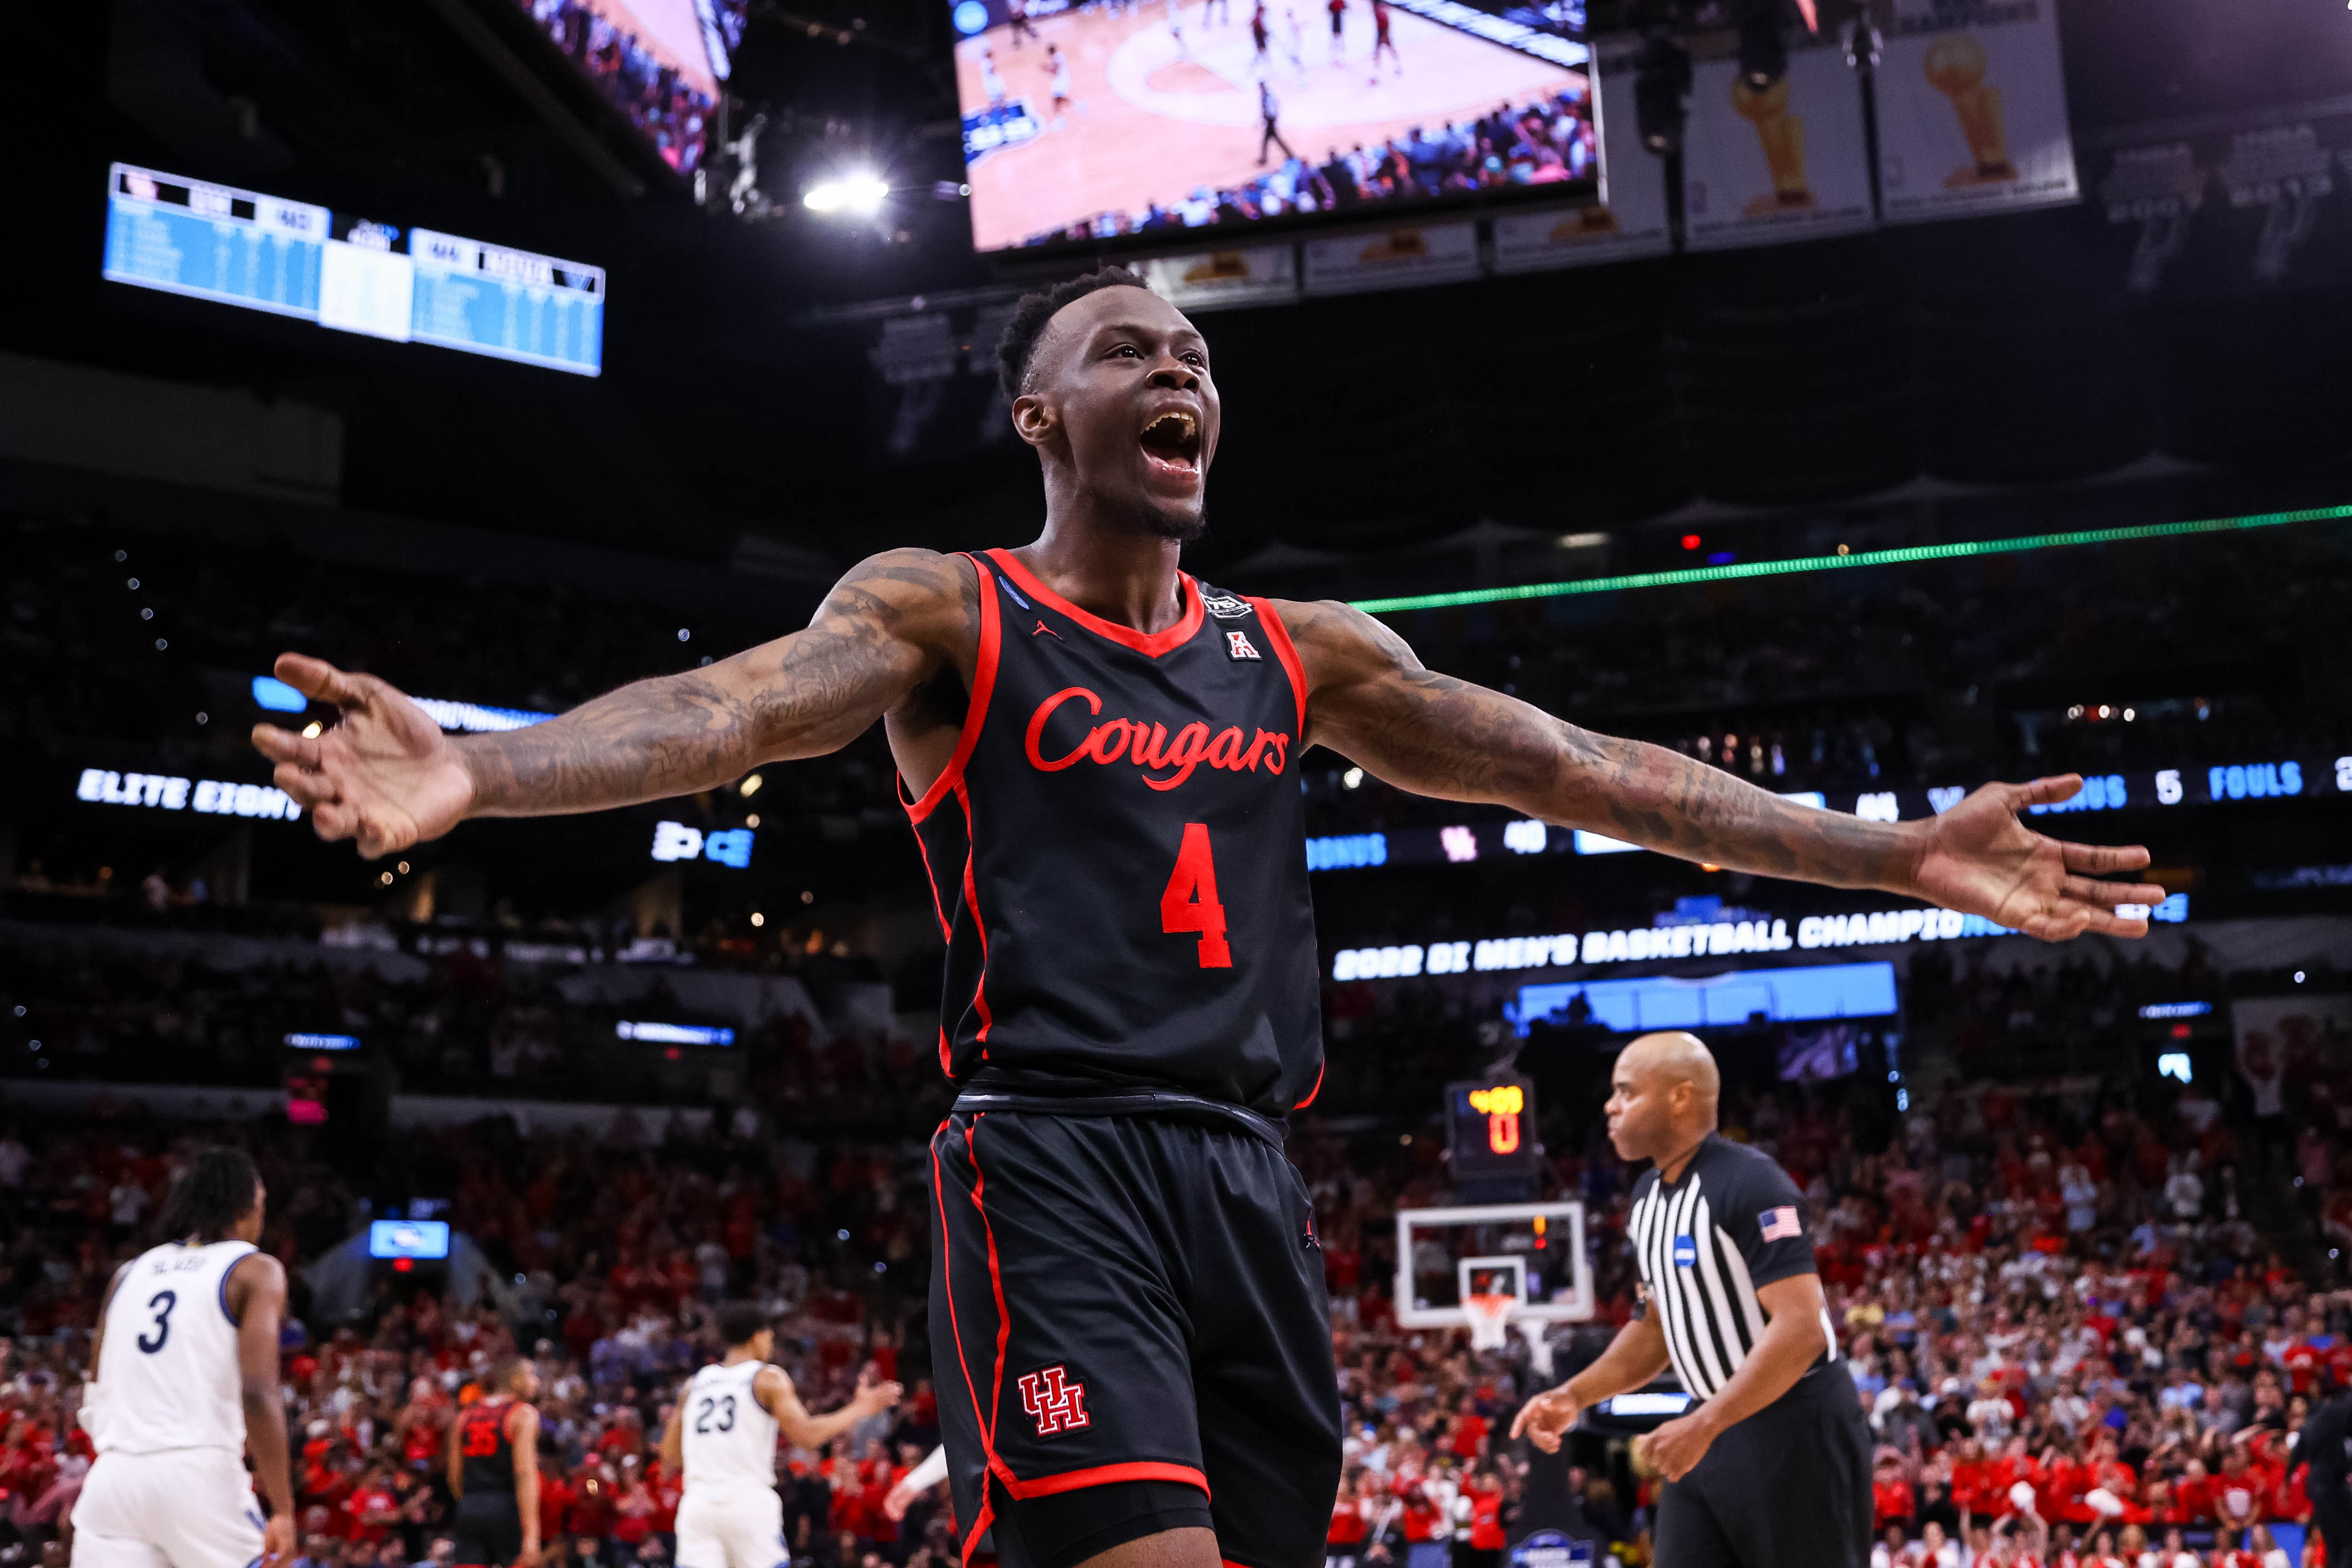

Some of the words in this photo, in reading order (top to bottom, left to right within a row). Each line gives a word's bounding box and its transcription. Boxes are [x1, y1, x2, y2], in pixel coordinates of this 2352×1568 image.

[1207, 600, 1237, 610] 75
[1025, 687, 1289, 791] Cougars
[77, 768, 191, 810] ELITE
[2155, 770, 2183, 804] 5
[2208, 760, 2304, 801] FOULS
[1160, 823, 1233, 968] 4
[1333, 945, 1424, 981] 2022
[1473, 934, 1578, 971] MEN'S
[1581, 919, 1793, 964] BASKETBALL
[137, 1290, 176, 1354] 3
[695, 1394, 737, 1435] 23
[1017, 1365, 1090, 1436] UH
